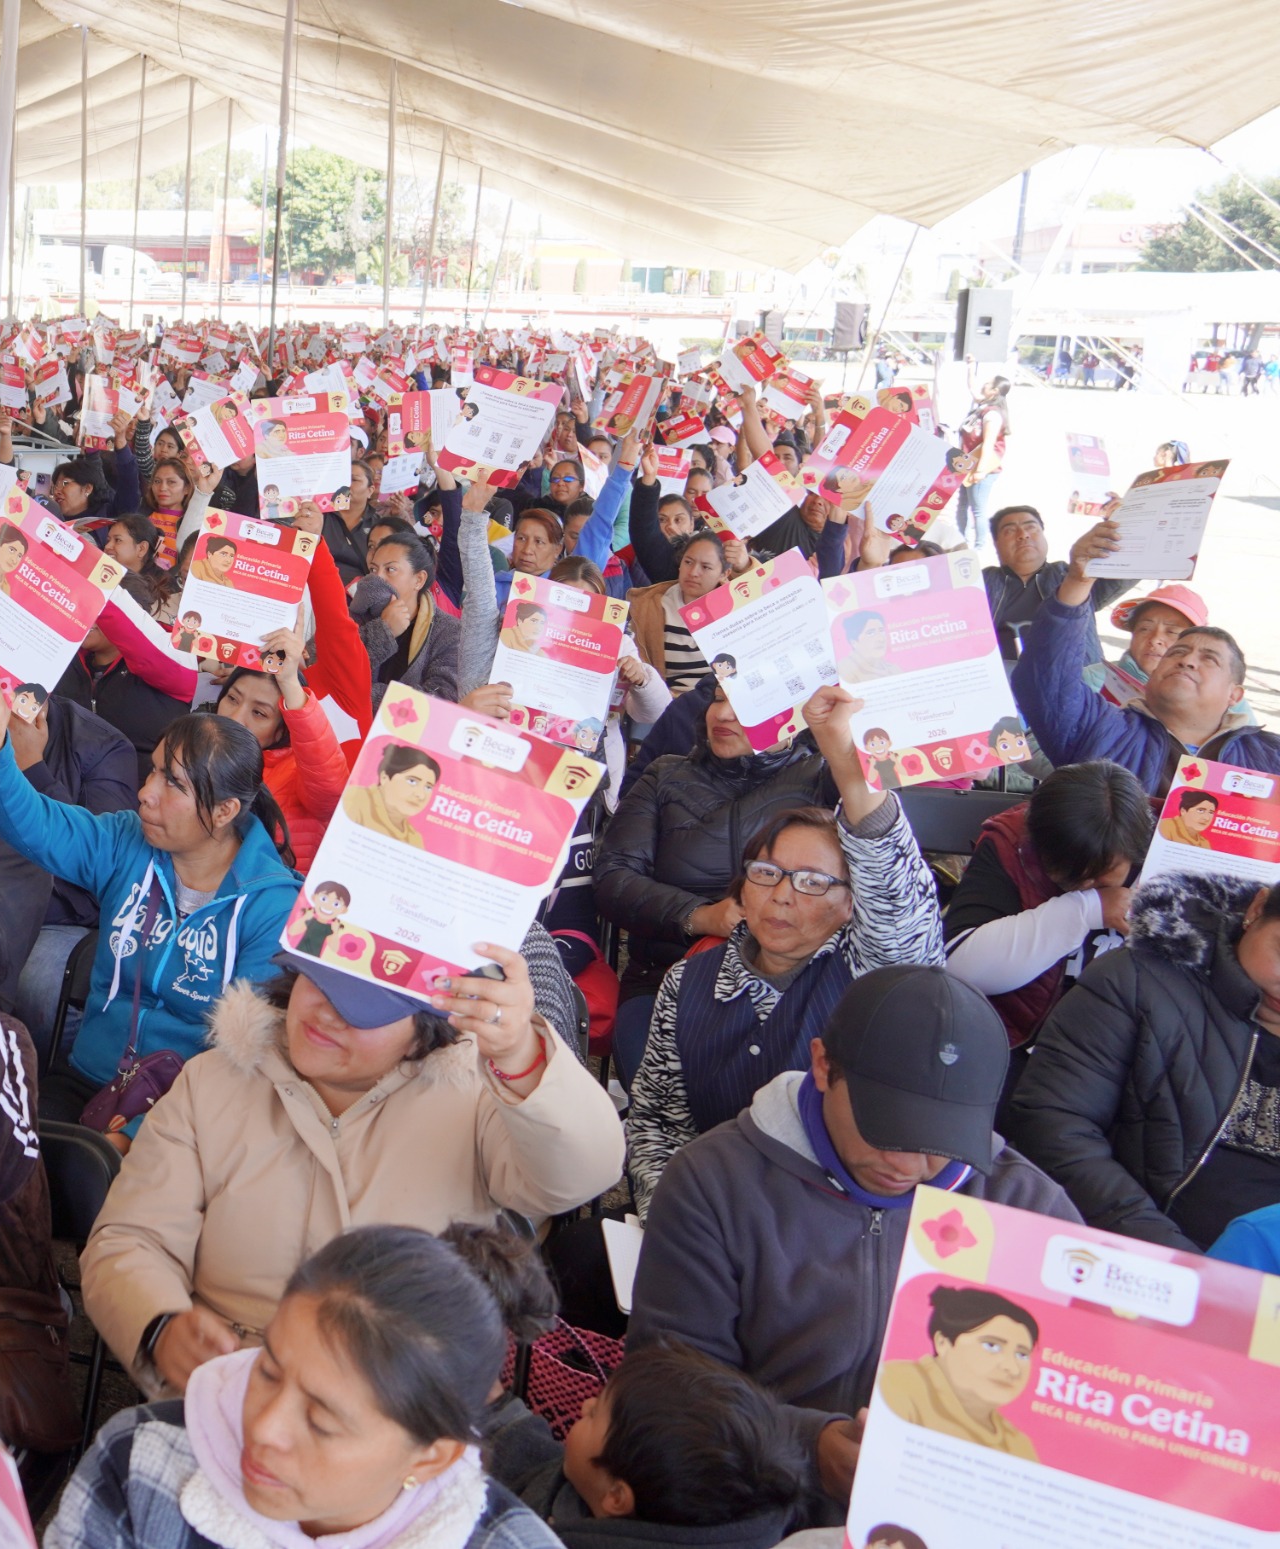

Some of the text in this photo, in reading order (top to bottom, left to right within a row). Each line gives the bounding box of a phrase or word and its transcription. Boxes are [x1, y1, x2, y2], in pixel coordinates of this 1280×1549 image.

[289, 429, 335, 440] Rita Cetina
[852, 454, 871, 473] Rita
[865, 426, 890, 455] Cetina
[55, 532, 75, 551] Becas
[234, 559, 290, 582] Rita Cetina
[236, 553, 282, 570] Educación Primaria
[19, 562, 77, 613] Rita Cetina
[24, 556, 71, 594] Educación Primaria
[722, 624, 743, 639] asesoría
[742, 618, 754, 629] para
[754, 611, 769, 621] hacer
[774, 595, 799, 612] solicitud?
[729, 618, 744, 630] dudas
[744, 611, 758, 621] sobre
[763, 601, 776, 612] beca
[779, 588, 803, 604] necesitas
[225, 629, 240, 638] 2026
[545, 627, 601, 651] Rita Cetina
[889, 619, 967, 645] Rita Cetina
[482, 735, 517, 756] Becas
[927, 728, 948, 738] 2026
[1243, 780, 1265, 790] Becas
[438, 783, 521, 820] Educación Primaria
[430, 794, 534, 846] Rita Cetina
[1212, 816, 1279, 839] Rita Cetina
[394, 926, 422, 944] 2026
[1104, 1262, 1173, 1295] Becas
[1041, 1347, 1215, 1410] Educación Primaria
[1035, 1366, 1251, 1457] Rita Cetina
[1031, 1399, 1064, 1420] BECA
[1065, 1409, 1083, 1427] DE
[1083, 1413, 1130, 1441] APOYO
[1131, 1428, 1167, 1452] PARA
[1168, 1440, 1248, 1476] UNIFORMES
